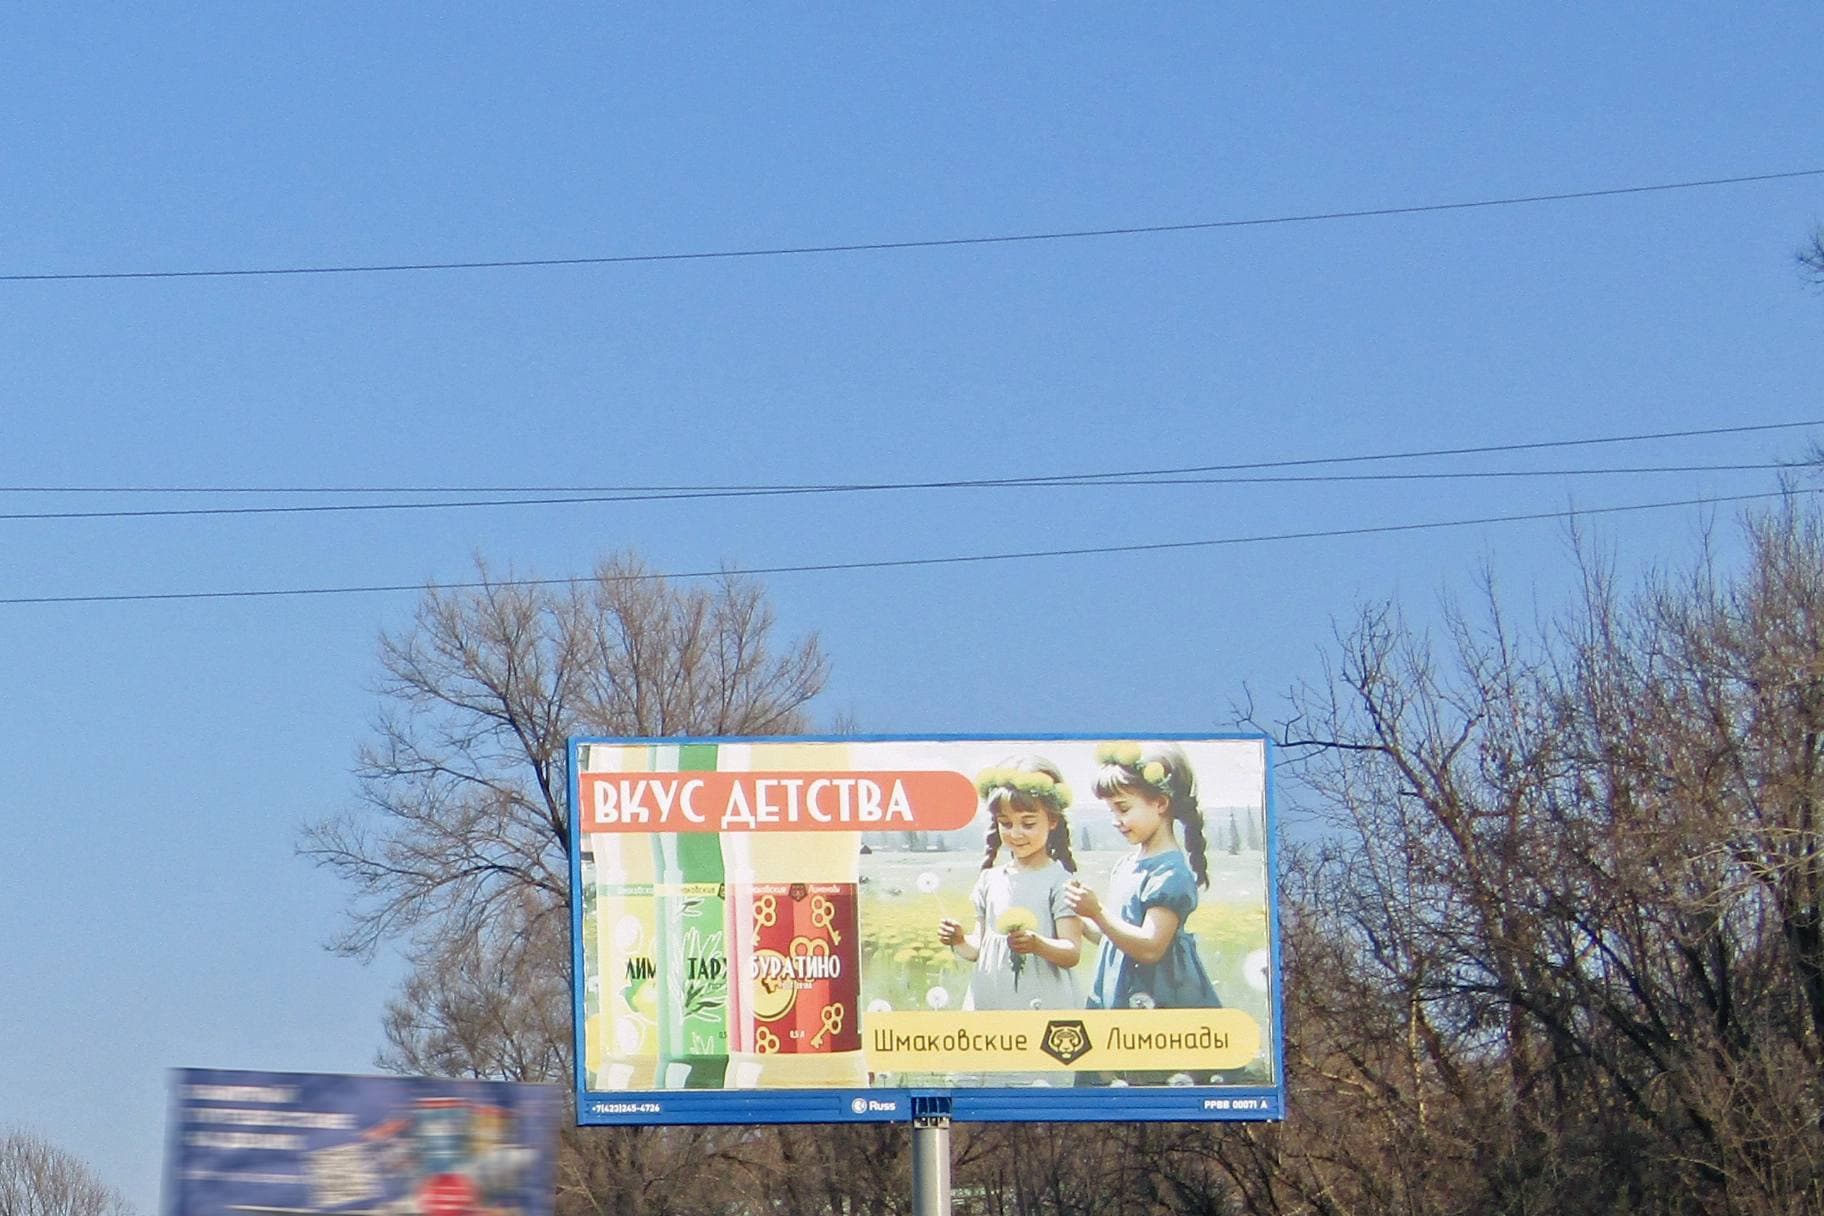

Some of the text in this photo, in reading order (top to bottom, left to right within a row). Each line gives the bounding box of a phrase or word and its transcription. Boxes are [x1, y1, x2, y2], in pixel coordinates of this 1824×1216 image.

[593, 778, 914, 829] ВКУС ДЕТСТВА
[751, 954, 841, 979] БУРАТИНО
[873, 1027, 1230, 1052] Шмаковские Лимонады
[868, 1100, 896, 1111] Russ
